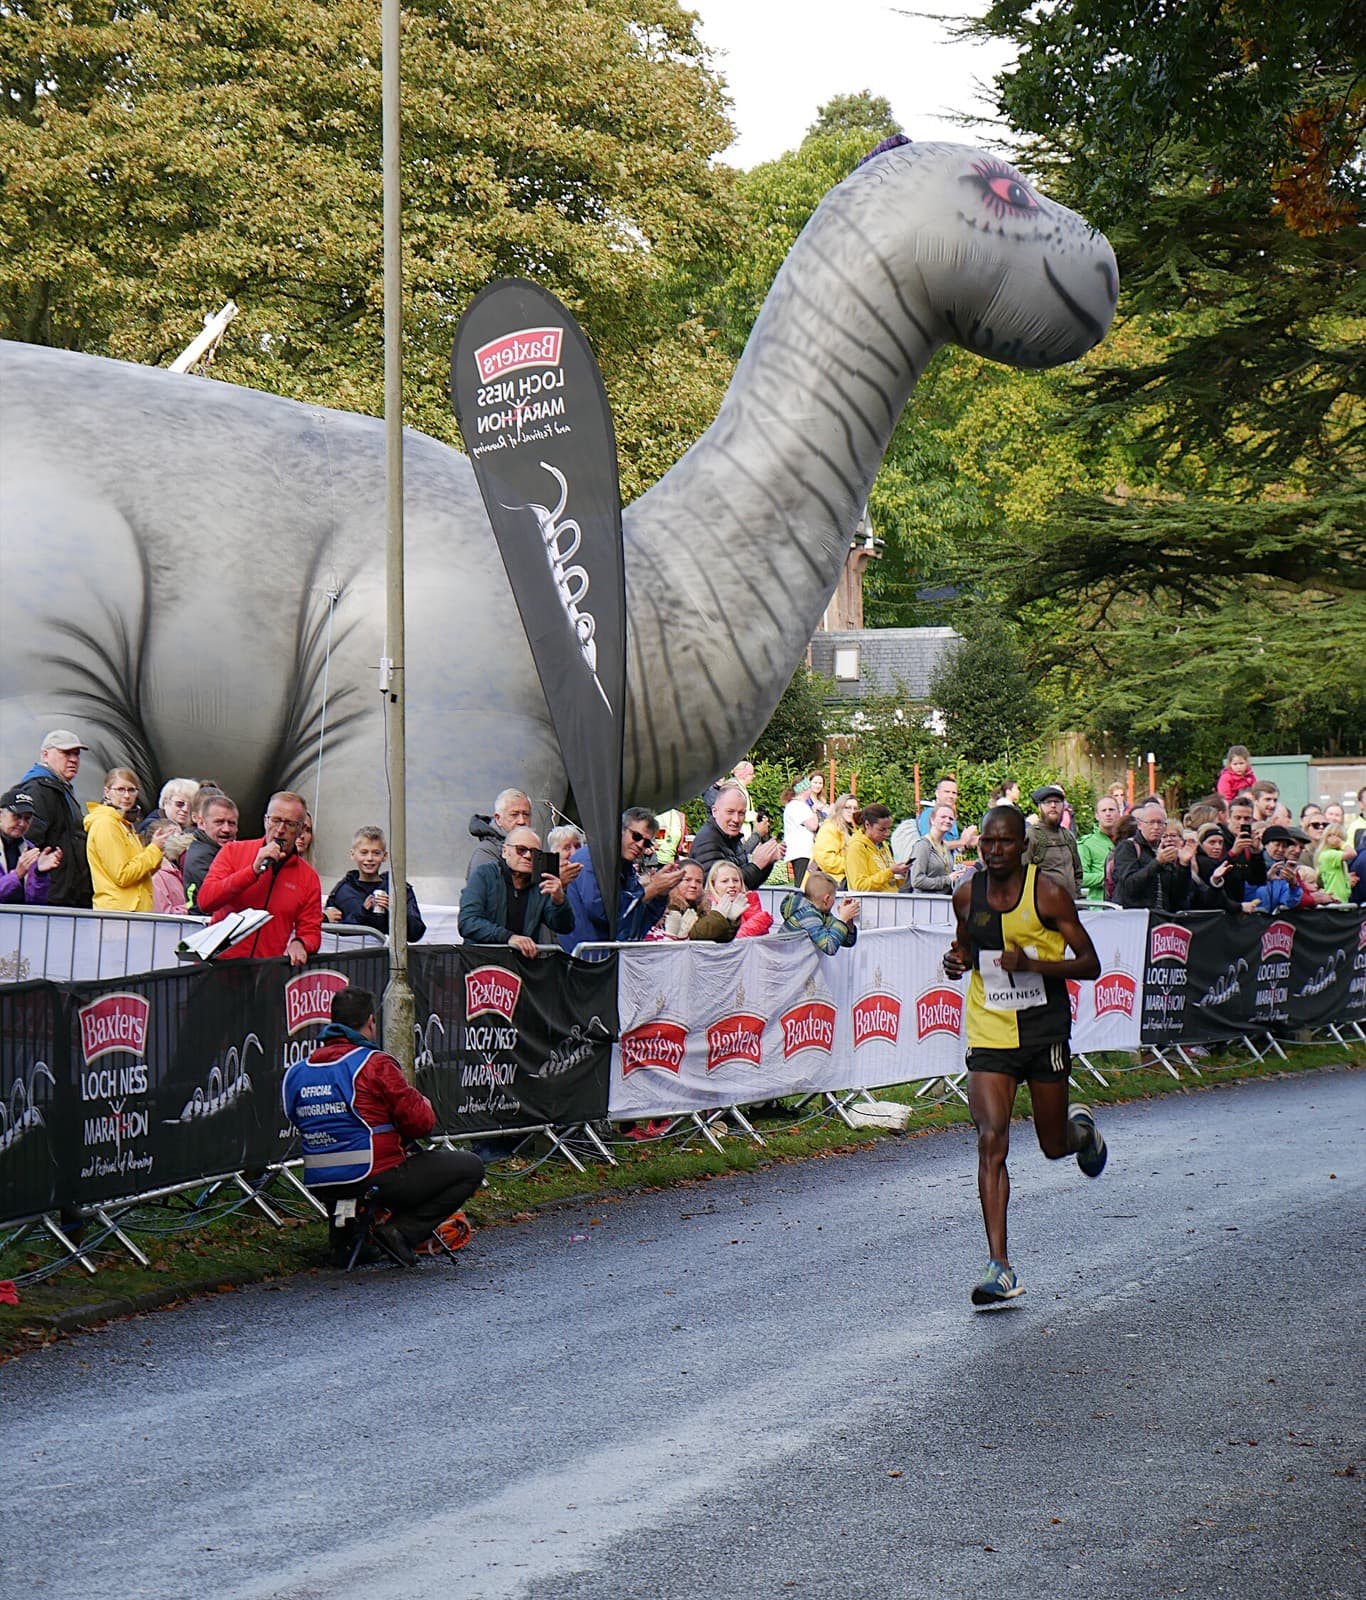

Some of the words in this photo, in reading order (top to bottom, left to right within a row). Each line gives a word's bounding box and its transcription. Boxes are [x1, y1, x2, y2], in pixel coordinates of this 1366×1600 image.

[1154, 930, 1187, 956] Baxters
[469, 977, 514, 1011] Baxters
[989, 991, 1013, 1001] LOCH
[1016, 987, 1041, 1000] NESS
[1147, 967, 1169, 985] LOCH
[1169, 968, 1188, 985] NESS
[290, 981, 336, 1022] Baxter
[1097, 979, 1134, 1012] Baxters
[85, 1005, 144, 1050] Baxters
[786, 1010, 833, 1051] Baxters
[855, 1002, 898, 1040] Baxters
[920, 997, 960, 1033] Baxters
[465, 1027, 494, 1051] LOCH
[624, 1030, 683, 1067] Baxters
[710, 1023, 760, 1063] Baxters
[81, 1069, 117, 1101] LOCH
[120, 1065, 148, 1095] NESS
[301, 1085, 332, 1098] OFFICIAL
